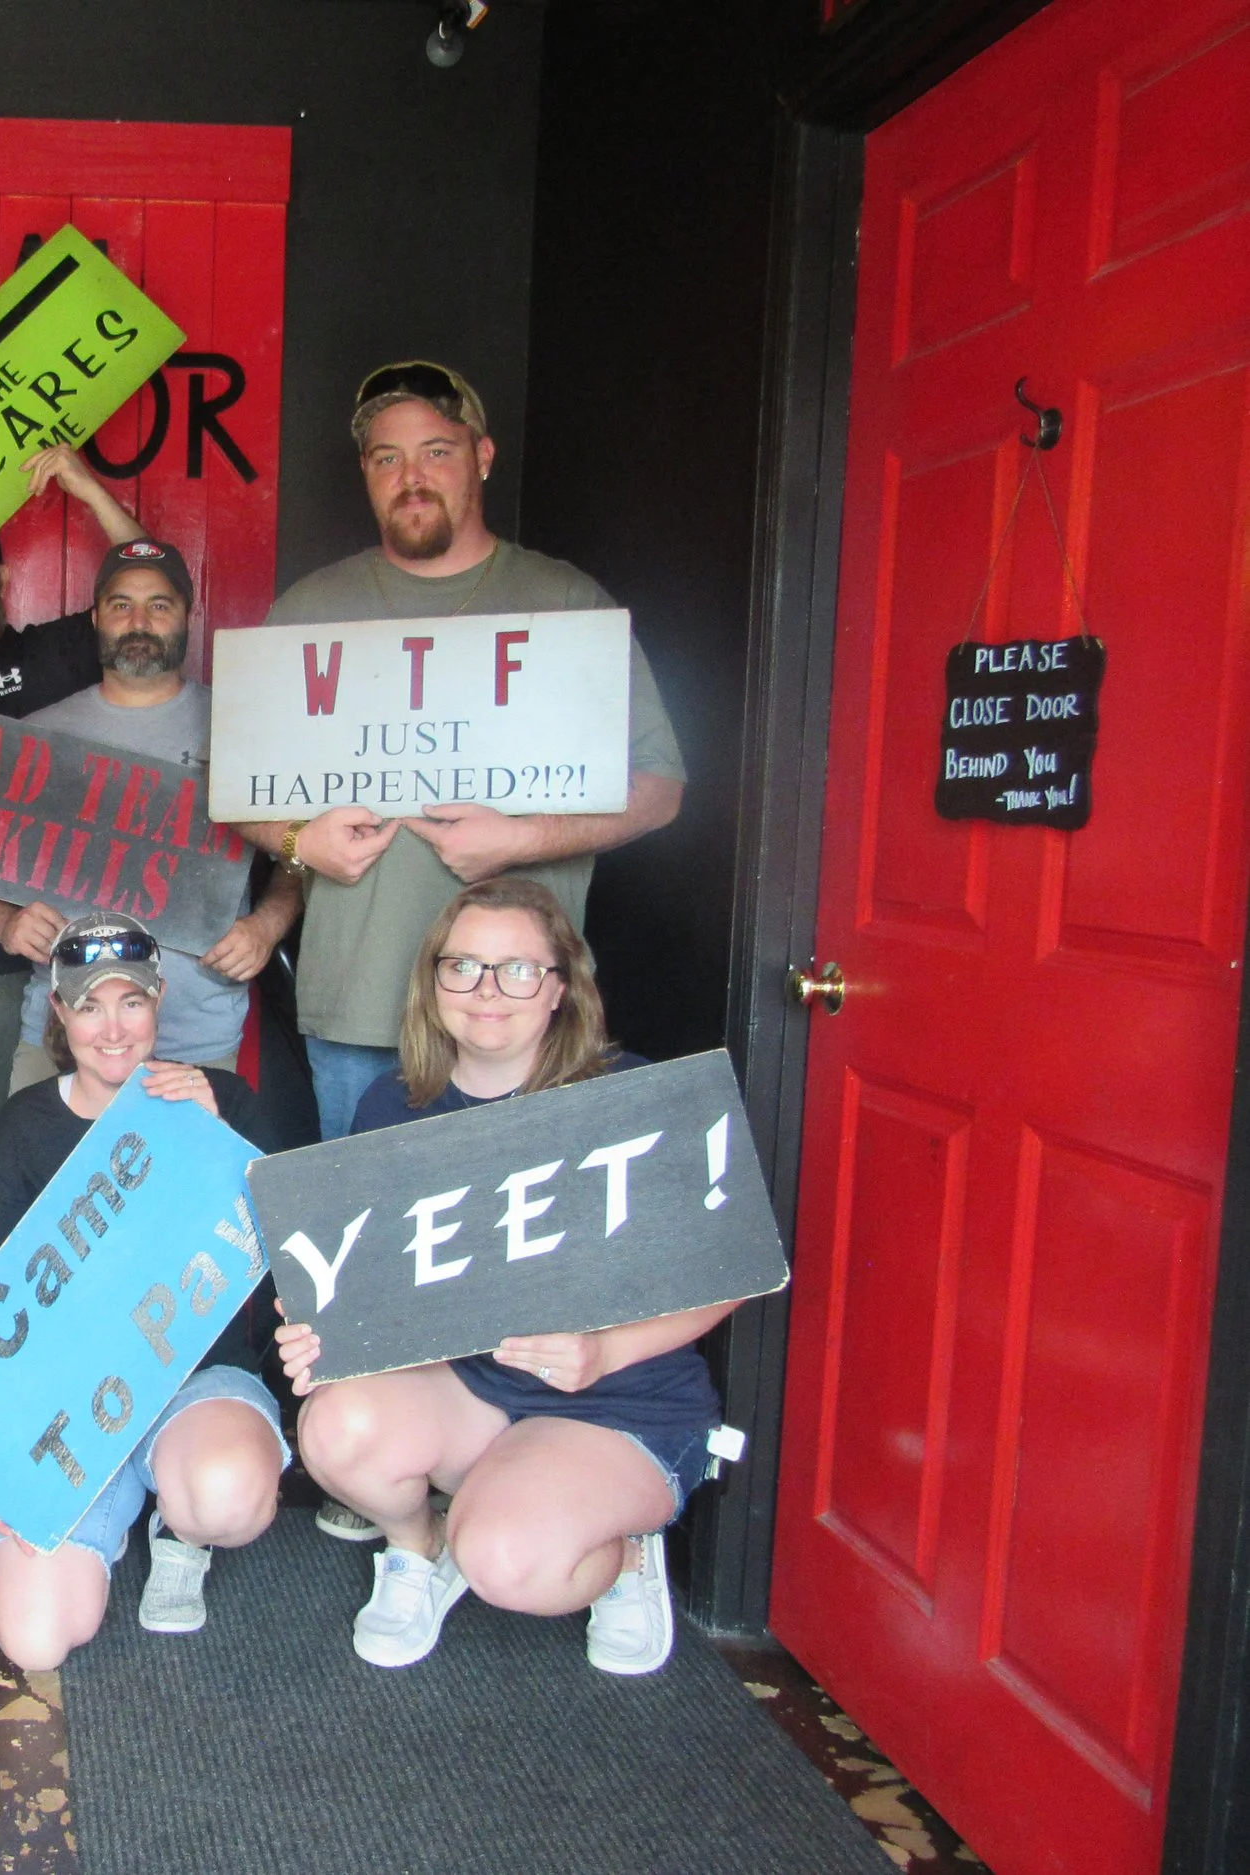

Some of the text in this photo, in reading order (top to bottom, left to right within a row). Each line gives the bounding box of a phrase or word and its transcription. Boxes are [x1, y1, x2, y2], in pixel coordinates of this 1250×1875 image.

[974, 643, 1069, 674] PLEASE
[950, 694, 1081, 729] CLOSE DOOR
[354, 721, 470, 758] JUST
[249, 764, 587, 807] HAPPENED?!?!
[29, 1192, 264, 1489] To Pay
